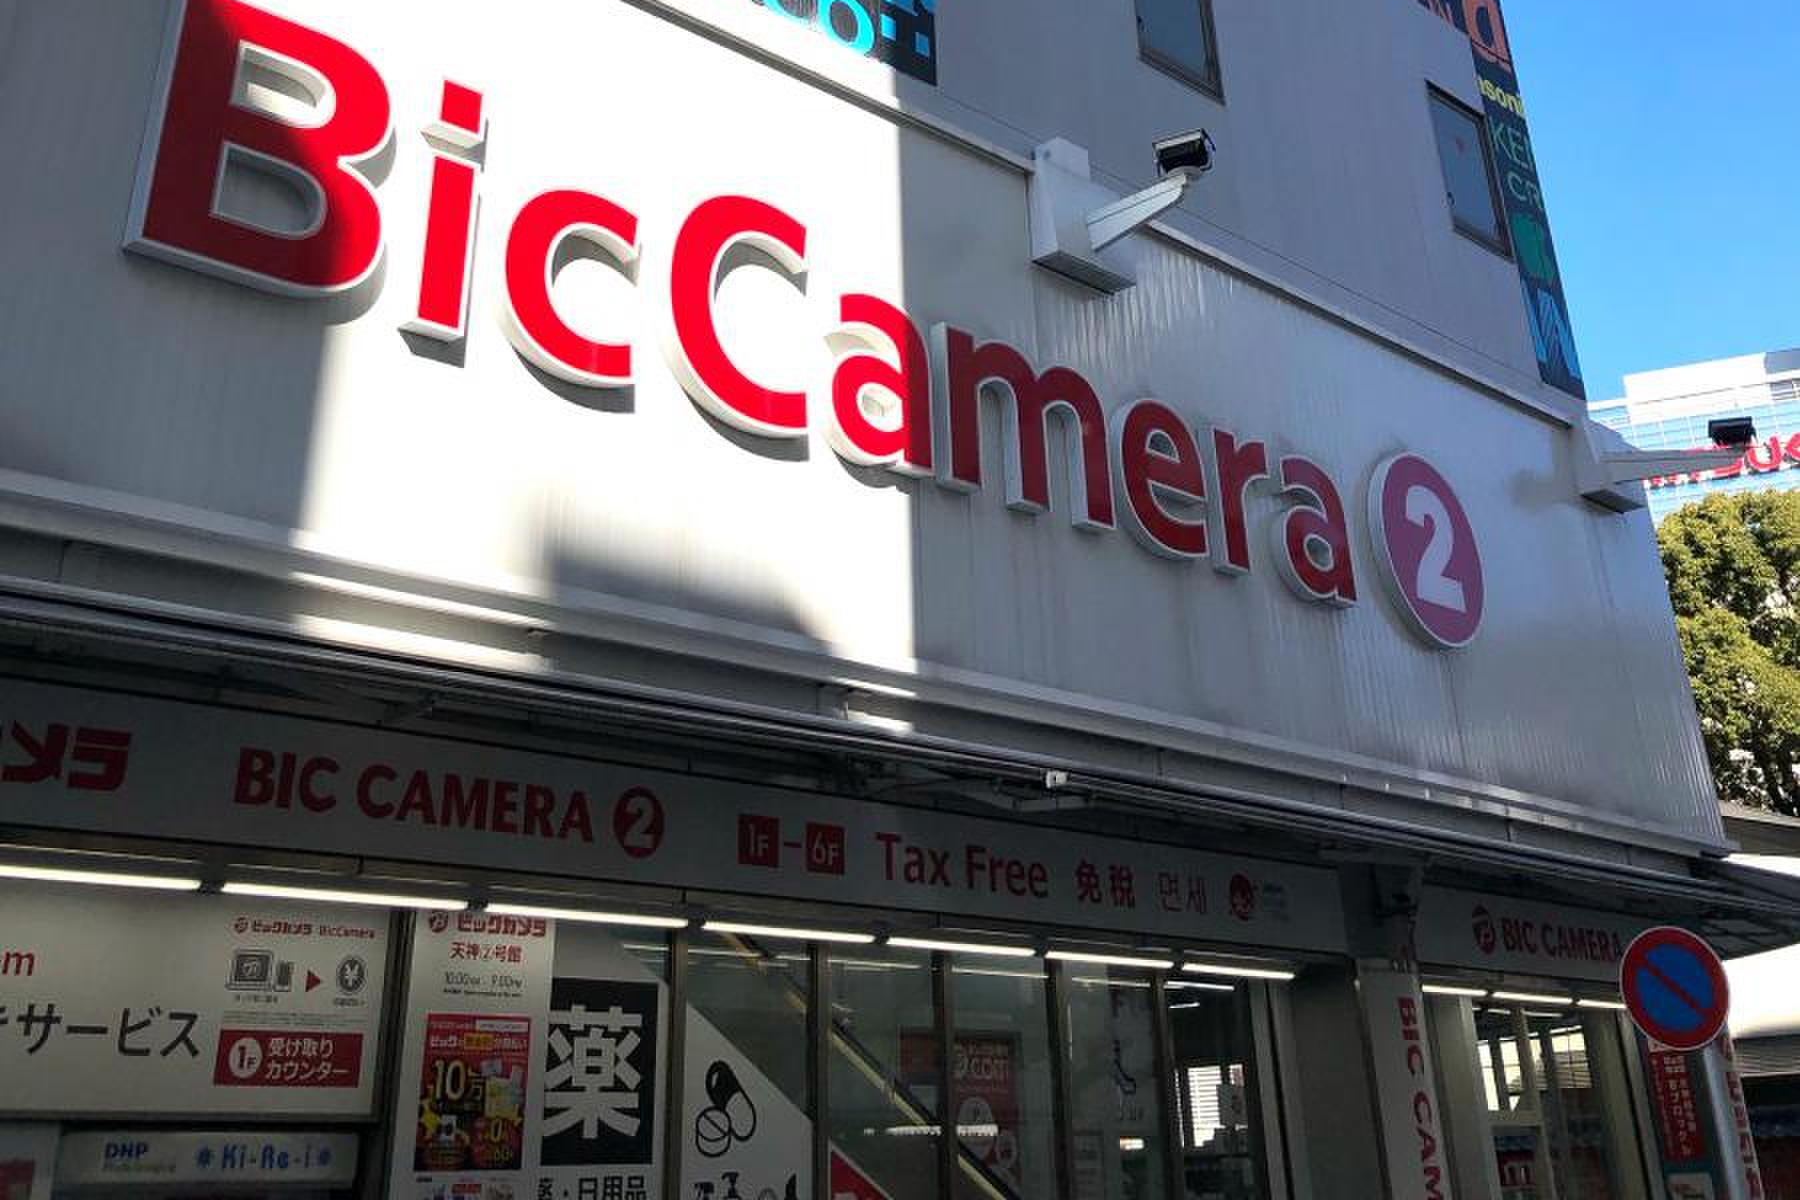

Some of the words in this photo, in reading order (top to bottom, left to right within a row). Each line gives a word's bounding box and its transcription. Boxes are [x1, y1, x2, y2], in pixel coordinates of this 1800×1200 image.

[233, 746, 340, 813] BIC
[356, 763, 595, 844] CAMERA
[876, 832, 951, 886] Tax
[966, 844, 1049, 899] Free
[1075, 857, 1136, 910] 免税
[1502, 918, 1538, 953] BIC
[0, 1003, 200, 1057] サービス
[268, 1037, 335, 1058] 受け取り
[264, 1060, 351, 1082] カウンター
[543, 1004, 643, 1140] 薬
[104, 1142, 149, 1161] DNP
